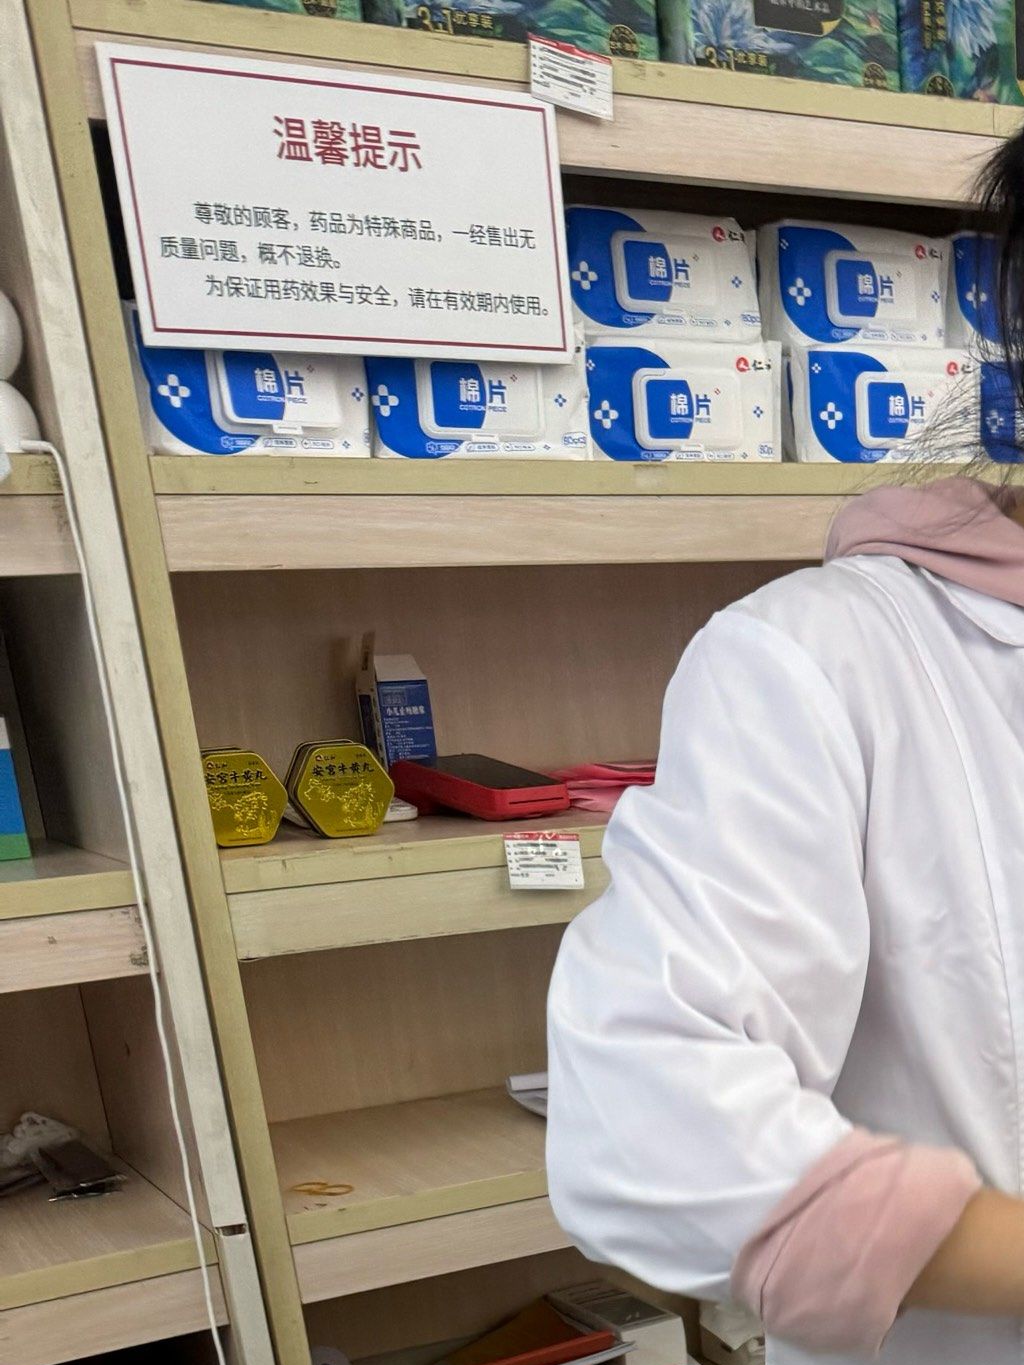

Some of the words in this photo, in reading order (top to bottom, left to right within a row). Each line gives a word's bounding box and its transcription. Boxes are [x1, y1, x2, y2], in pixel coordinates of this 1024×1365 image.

[273, 115, 422, 172] 温馨提示
[193, 201, 536, 249] 尊敬的顾客，药品为特殊商品，一经售出无
[160, 236, 342, 269] 质量问题，概不退换。
[648, 255, 691, 281] 棉片
[205, 275, 549, 317] 为保证用药效果与安全，请在有效期内使用。
[857, 273, 894, 296] 棉片
[254, 367, 305, 398] 棉片
[458, 377, 507, 404] 棉片
[670, 393, 711, 416] 棉片
[888, 395, 925, 416] 棉片
[312, 762, 375, 776] 安宫牛黄丸
